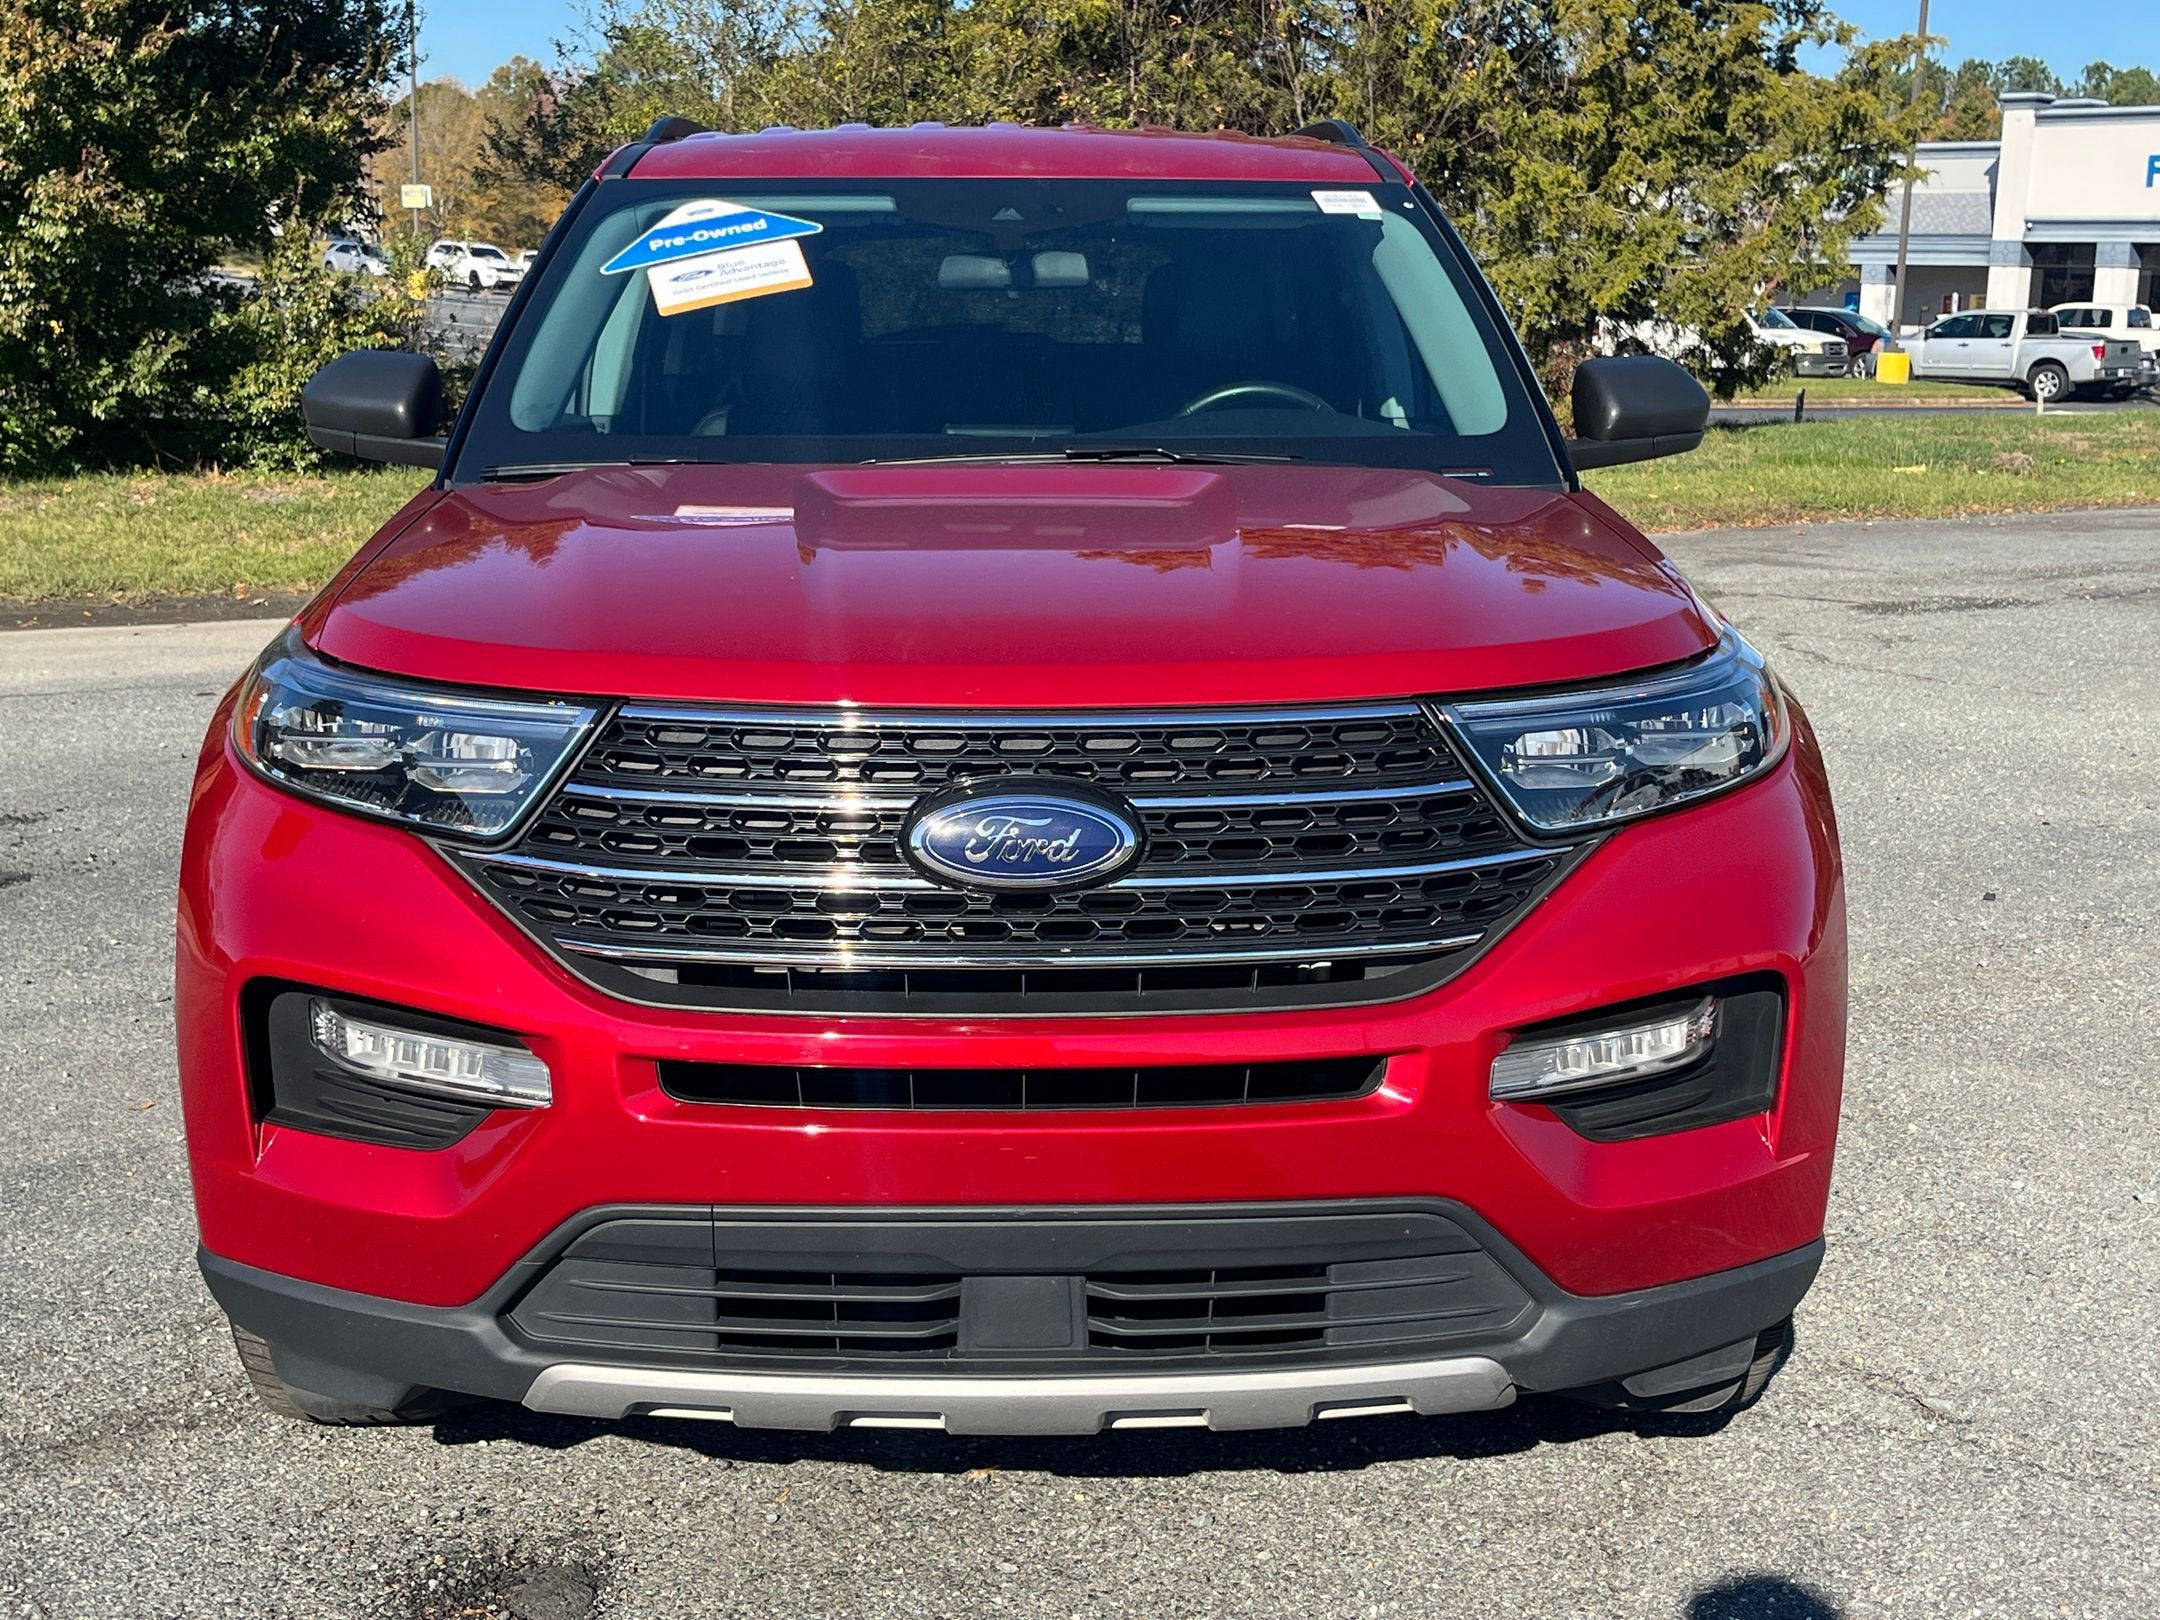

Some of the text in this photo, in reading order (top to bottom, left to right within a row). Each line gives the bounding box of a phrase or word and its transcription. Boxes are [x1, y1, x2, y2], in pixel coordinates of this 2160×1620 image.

[649, 218, 768, 252] Pre-Owned
[717, 260, 745, 270] Blue
[720, 259, 786, 276] Advantage
[696, 279, 732, 291] Certified
[965, 815, 1081, 863] Ford
